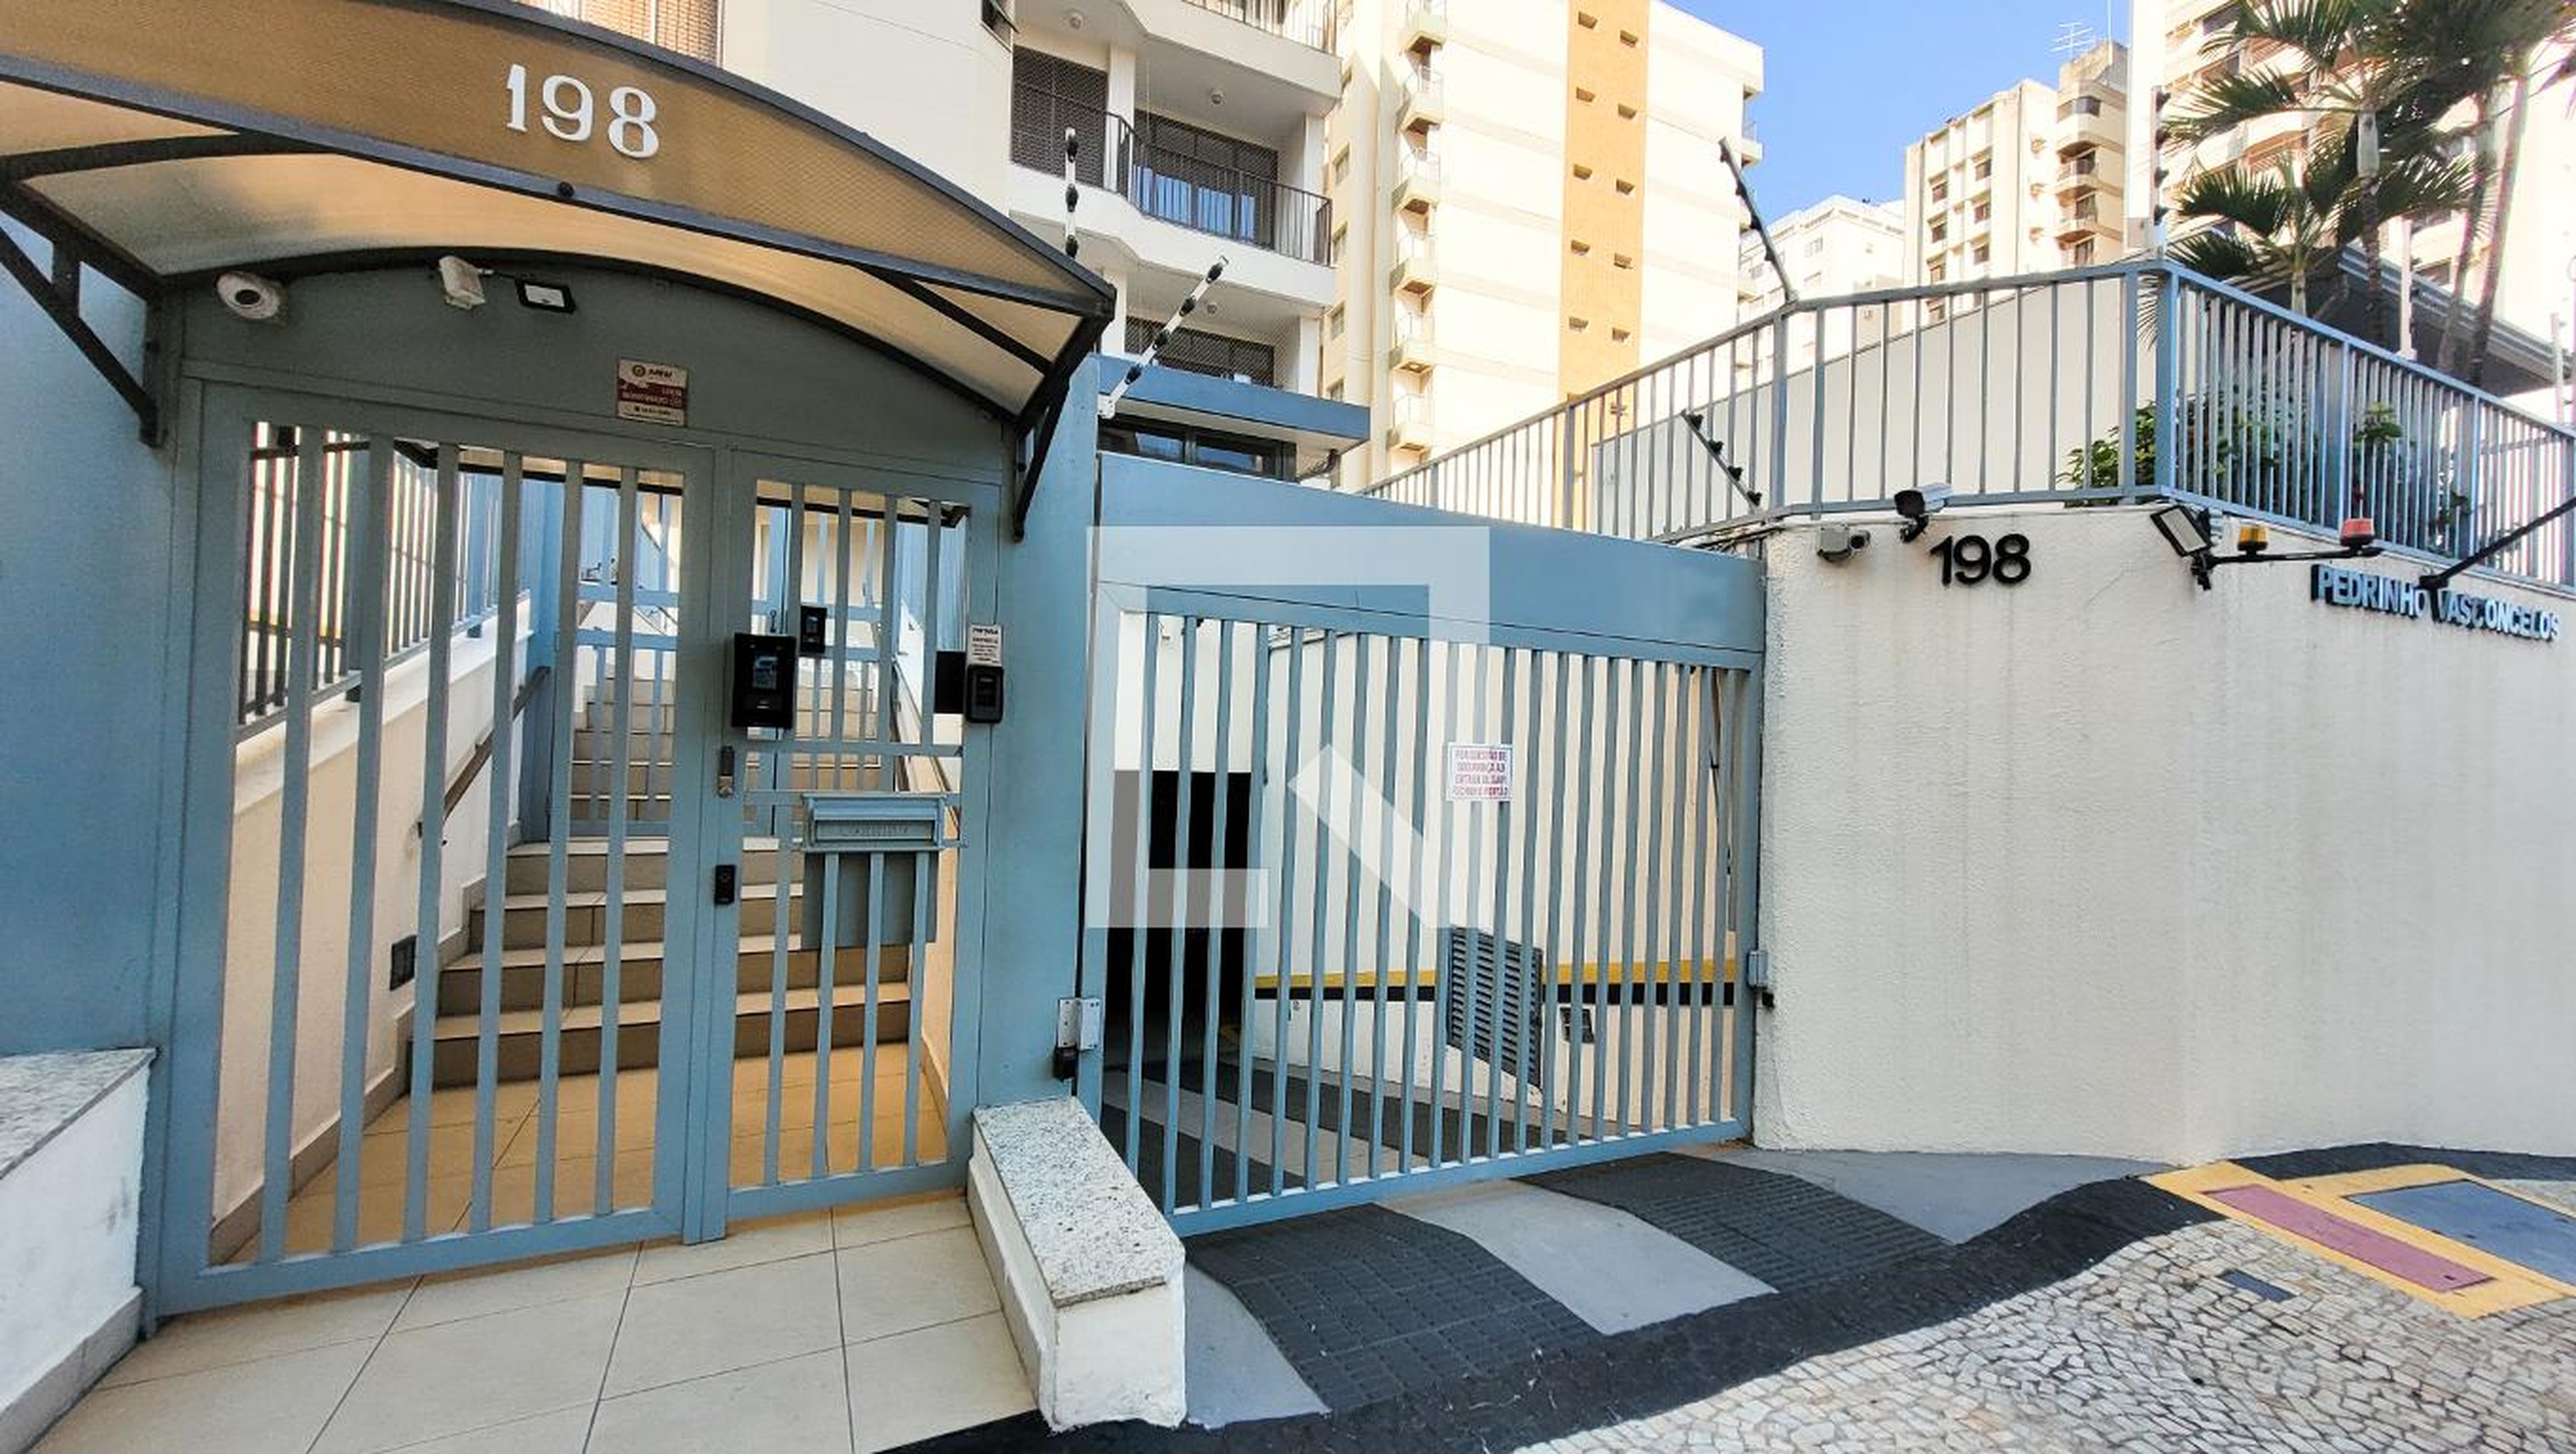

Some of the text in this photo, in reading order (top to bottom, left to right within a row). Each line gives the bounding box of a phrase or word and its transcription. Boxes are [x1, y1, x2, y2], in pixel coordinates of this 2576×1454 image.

[506, 63, 659, 158] 198
[1930, 533, 2031, 586] 198
[2312, 564, 2560, 641] PEDRINHO VASCONCELOS
